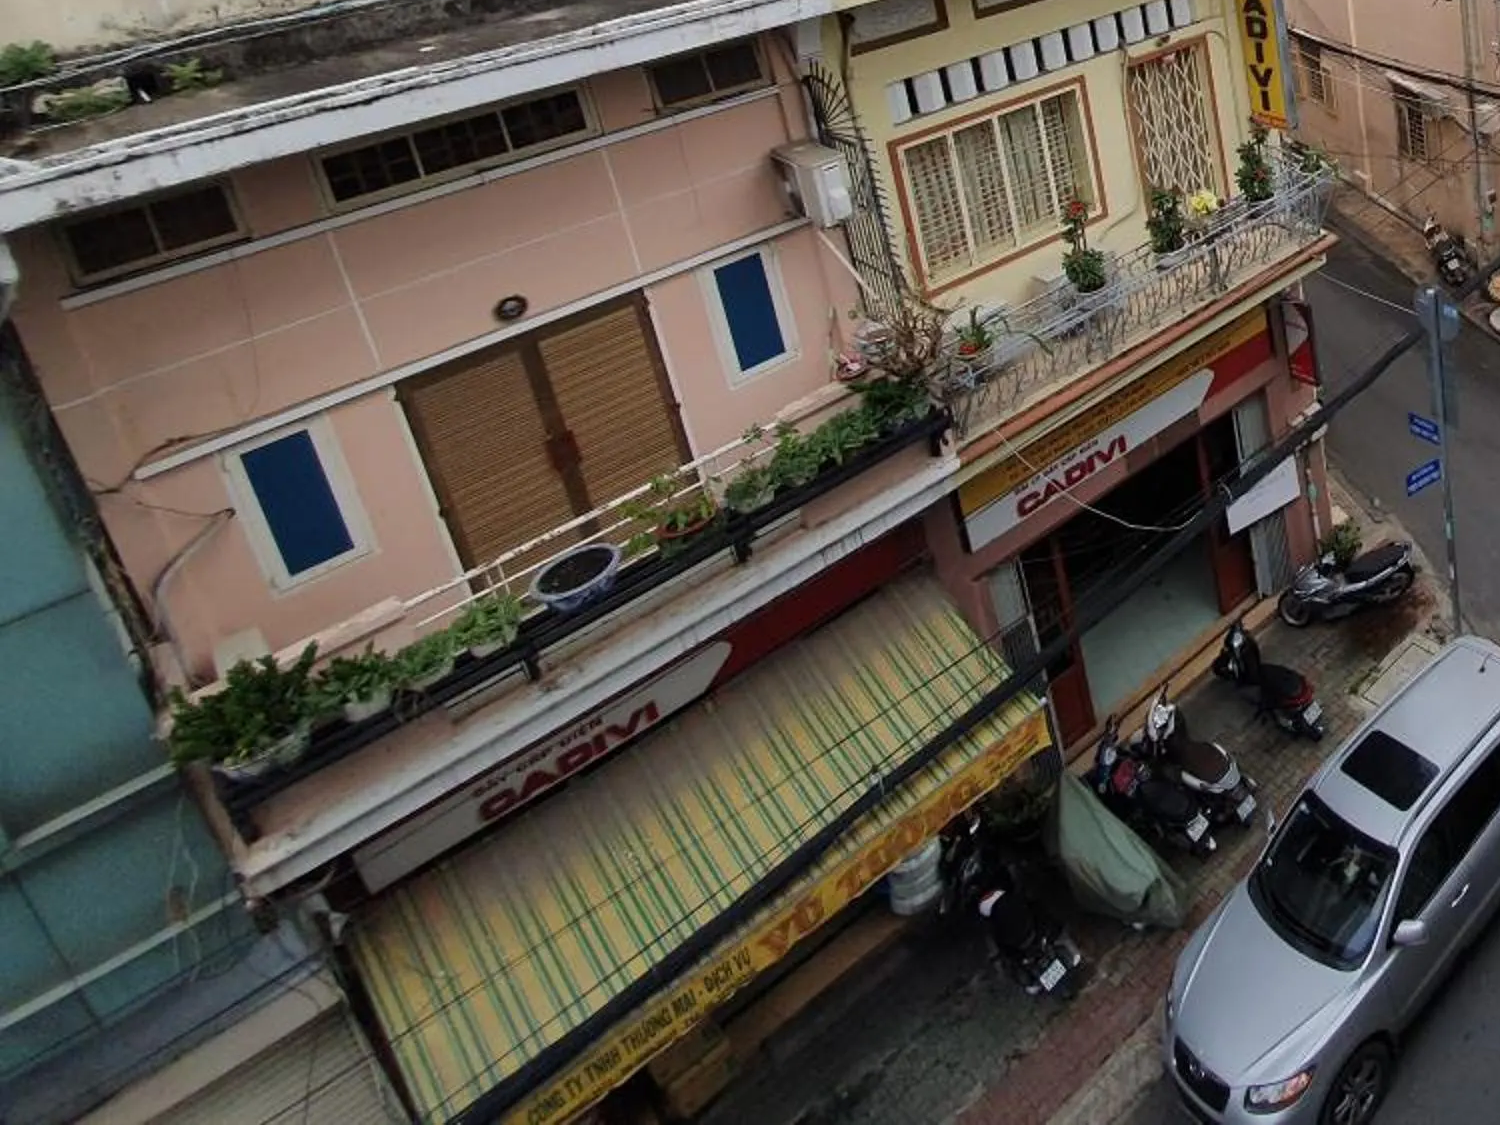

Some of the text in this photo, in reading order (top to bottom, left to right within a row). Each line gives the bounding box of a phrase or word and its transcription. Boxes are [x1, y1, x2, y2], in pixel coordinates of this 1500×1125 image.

[1016, 434, 1127, 517] CADIVI
[480, 700, 660, 820] CADIVI
[563, 1069, 584, 1097] TY
[584, 1045, 623, 1083] TNHH
